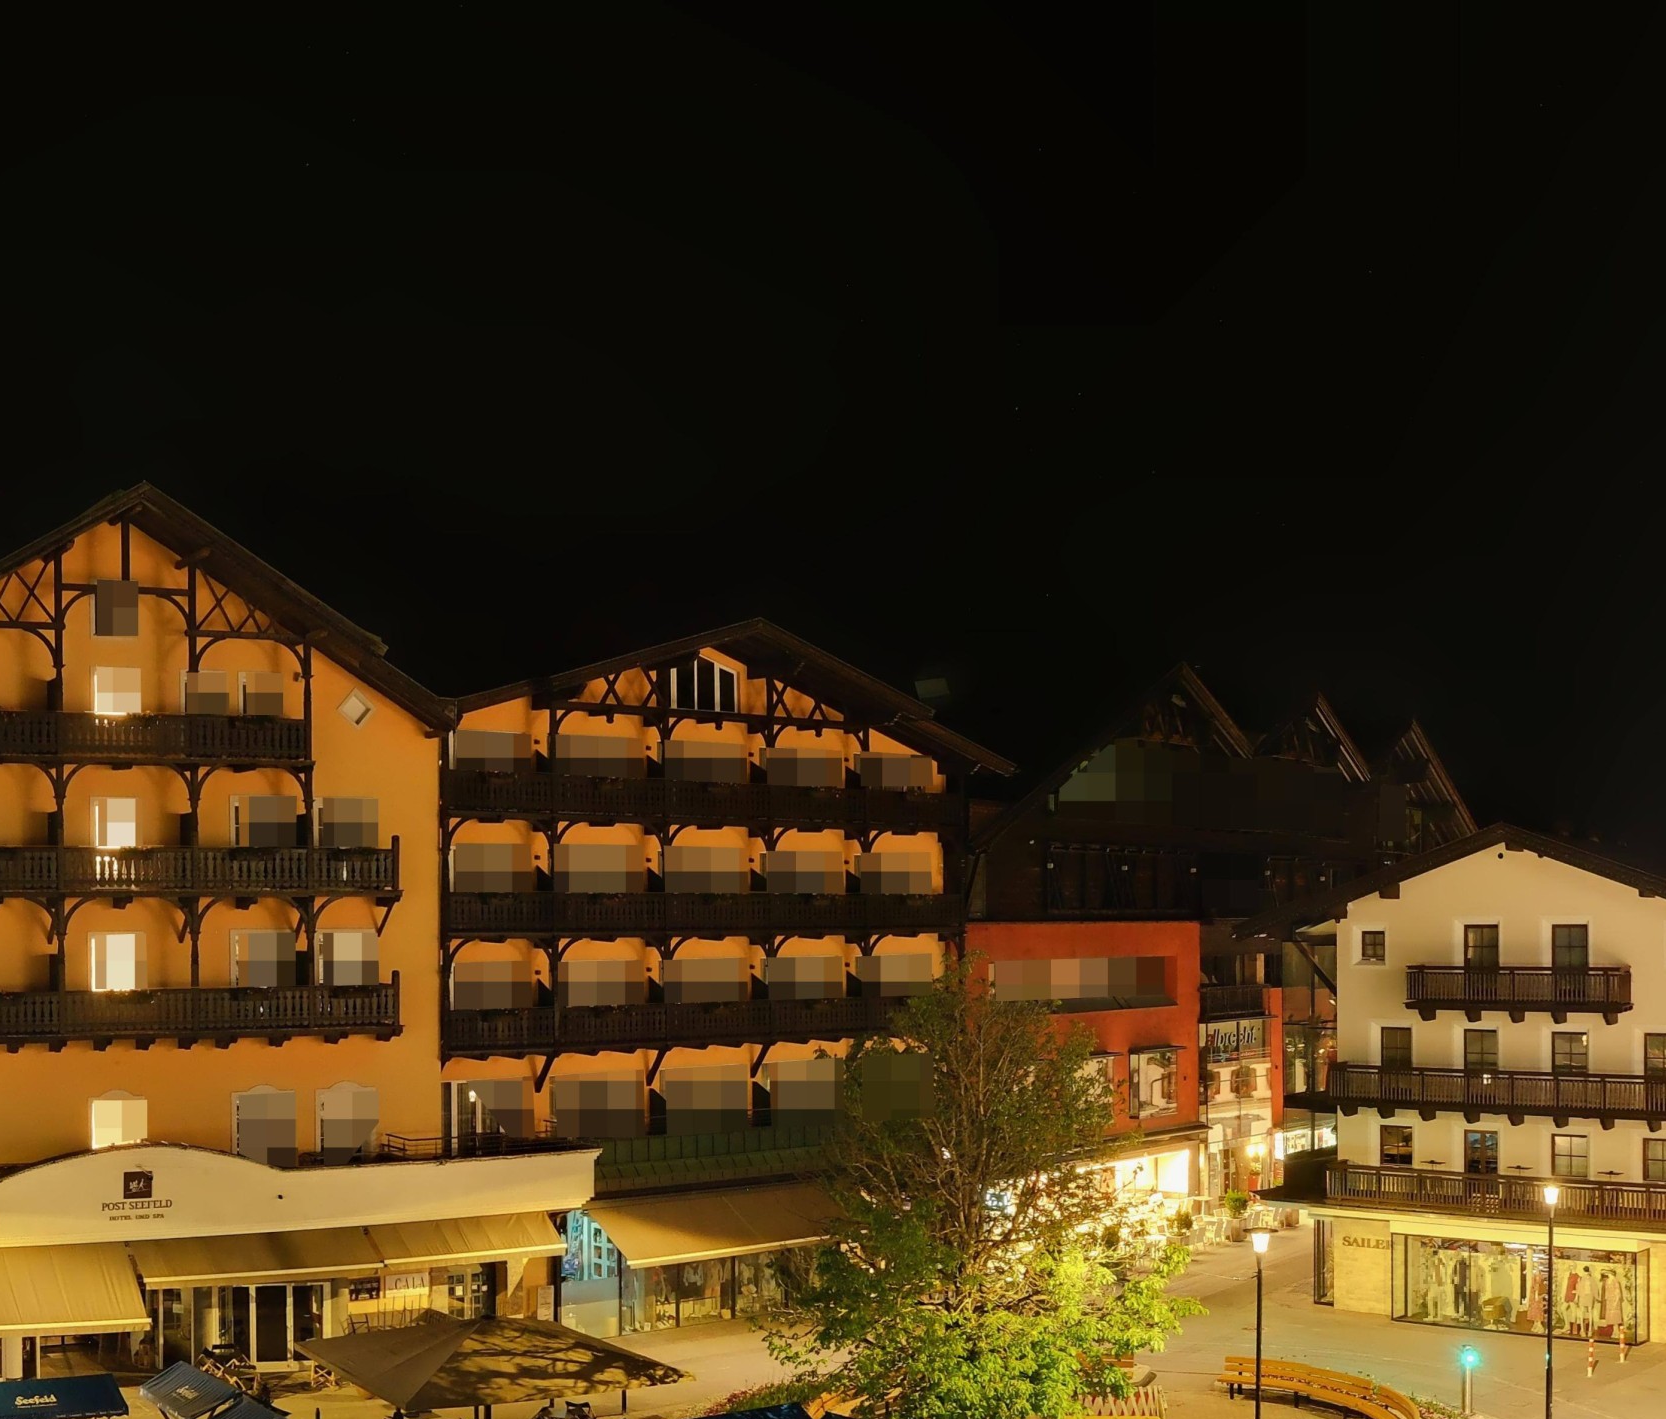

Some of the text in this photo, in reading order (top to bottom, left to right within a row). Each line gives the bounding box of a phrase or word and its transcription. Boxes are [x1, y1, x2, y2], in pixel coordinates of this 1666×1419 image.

[102, 1199, 173, 1211] POST SEEFELD
[15, 1394, 58, 1406] Seefeld
